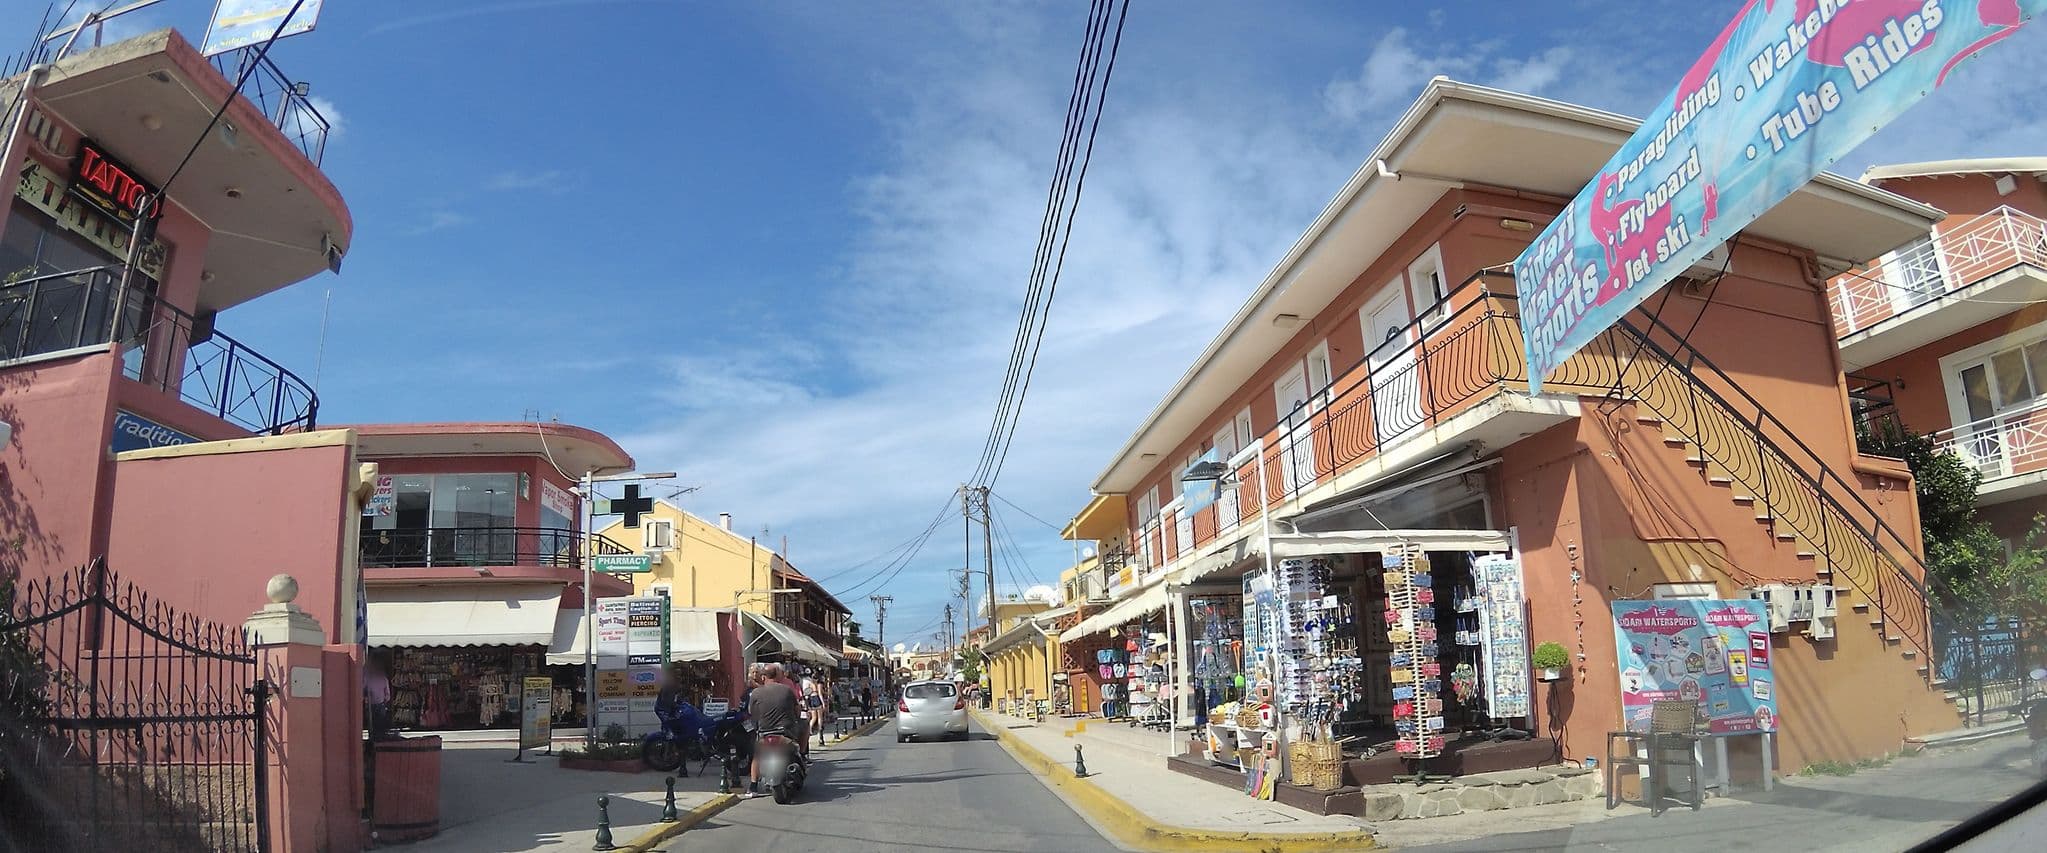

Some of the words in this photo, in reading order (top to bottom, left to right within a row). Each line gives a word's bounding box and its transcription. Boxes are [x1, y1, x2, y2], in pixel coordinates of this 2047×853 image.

[1761, 80, 1841, 153] Tube
[1843, 0, 1944, 92] Rides
[1617, 72, 1720, 193] Paragliding
[1619, 147, 1701, 242] Flyboard
[1519, 201, 1575, 298] Sidari
[1525, 248, 1575, 332] Water
[1625, 248, 1652, 290] Jet
[1656, 214, 1691, 264] ski
[1532, 263, 1599, 369] Sports
[598, 557, 648, 565] PHARMACY
[1643, 616, 1697, 627] WATERSPORTS
